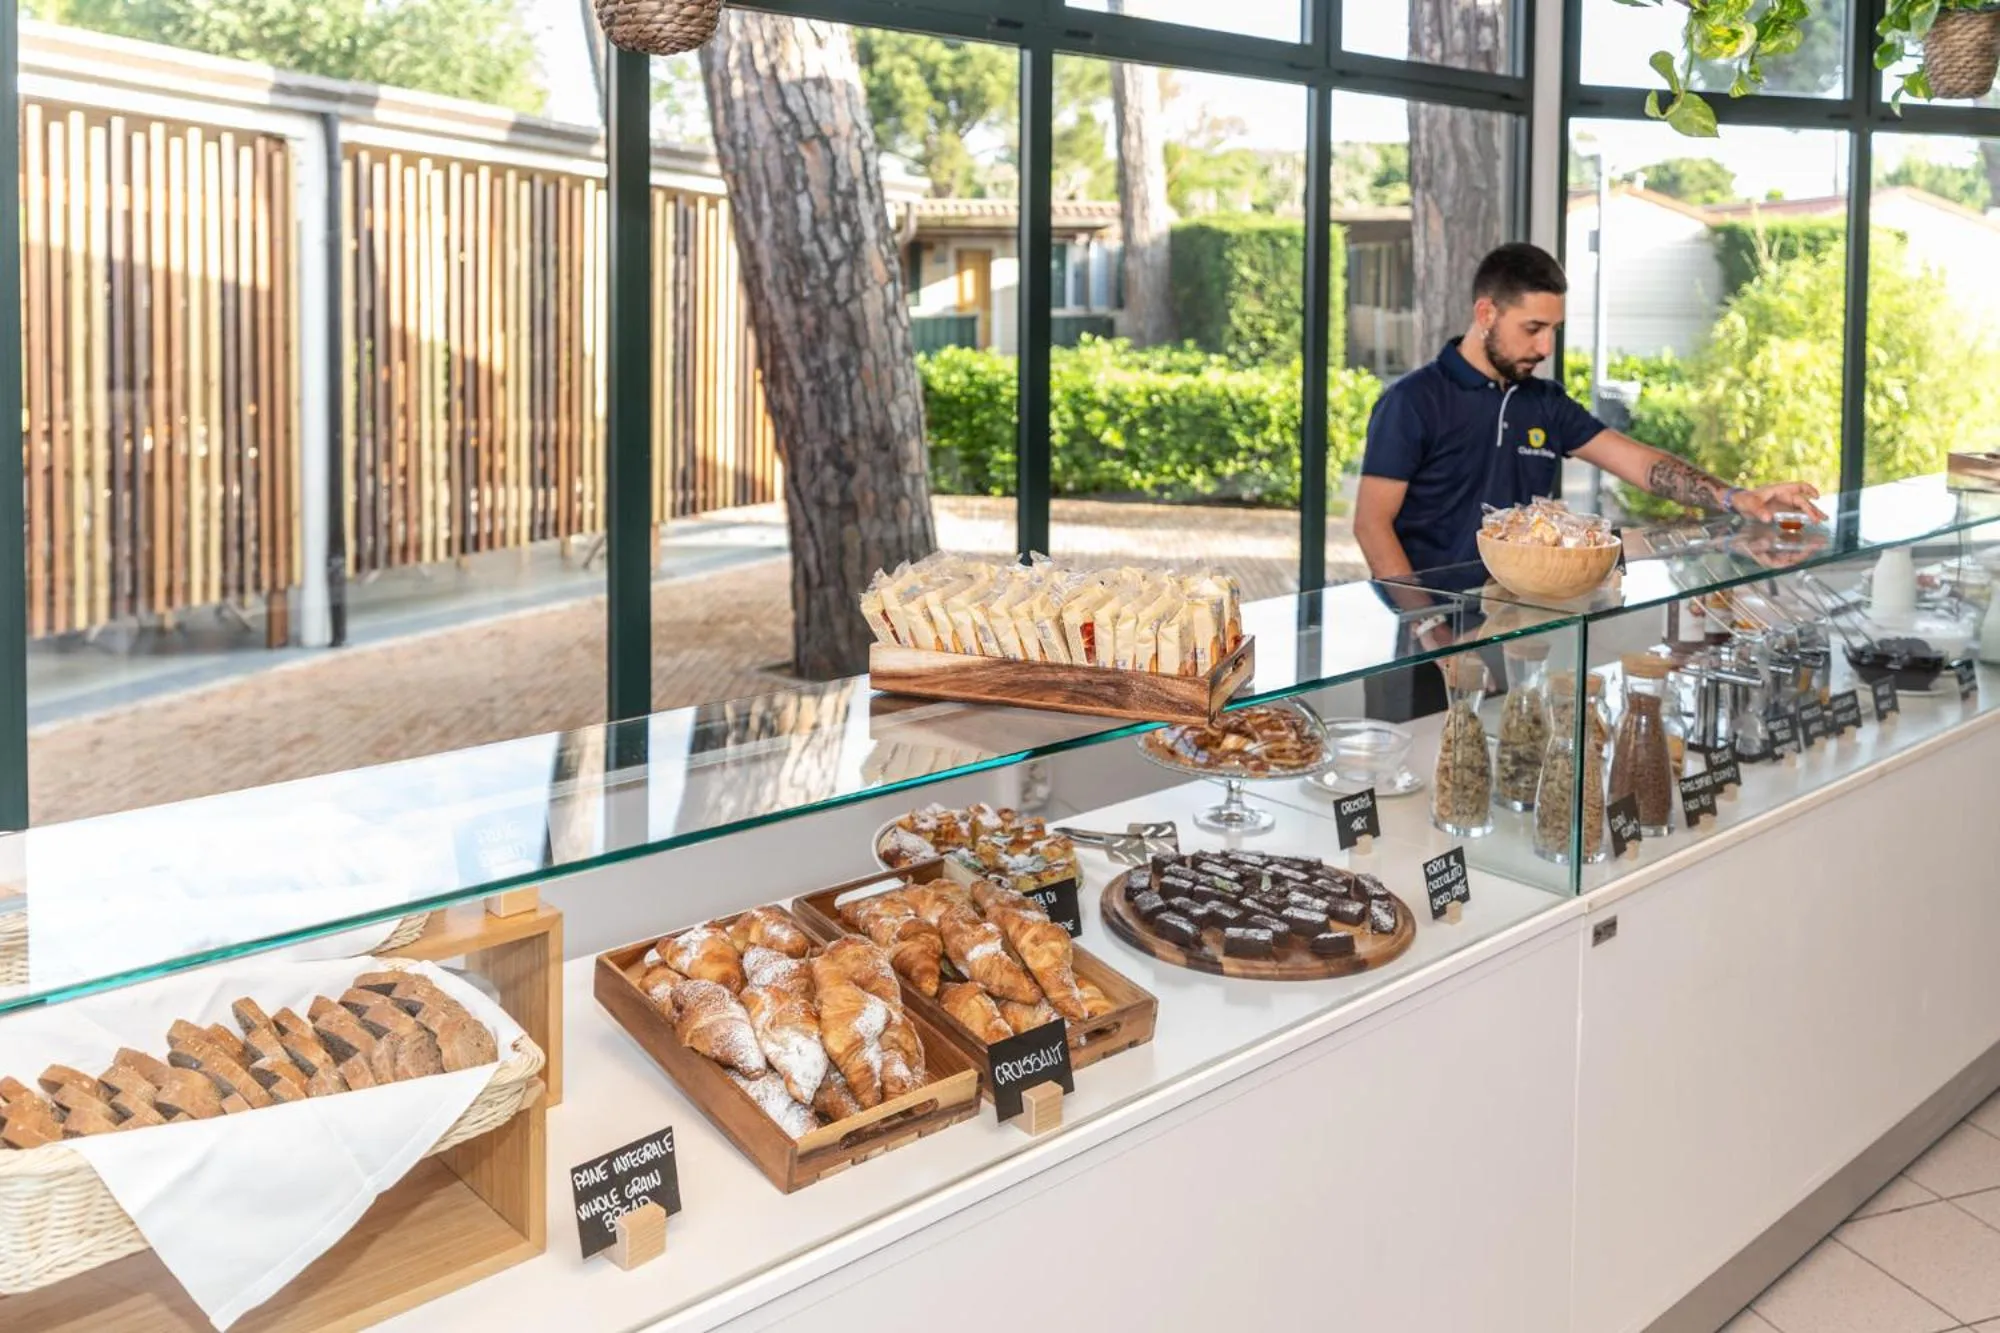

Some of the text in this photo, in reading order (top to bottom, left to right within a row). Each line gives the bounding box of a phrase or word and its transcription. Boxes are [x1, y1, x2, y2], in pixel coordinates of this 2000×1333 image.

[995, 1040, 1064, 1086] CROISSANT
[572, 1132, 674, 1191] PANE INTEGRALE
[576, 1169, 662, 1222] WHOLE GRAIN
